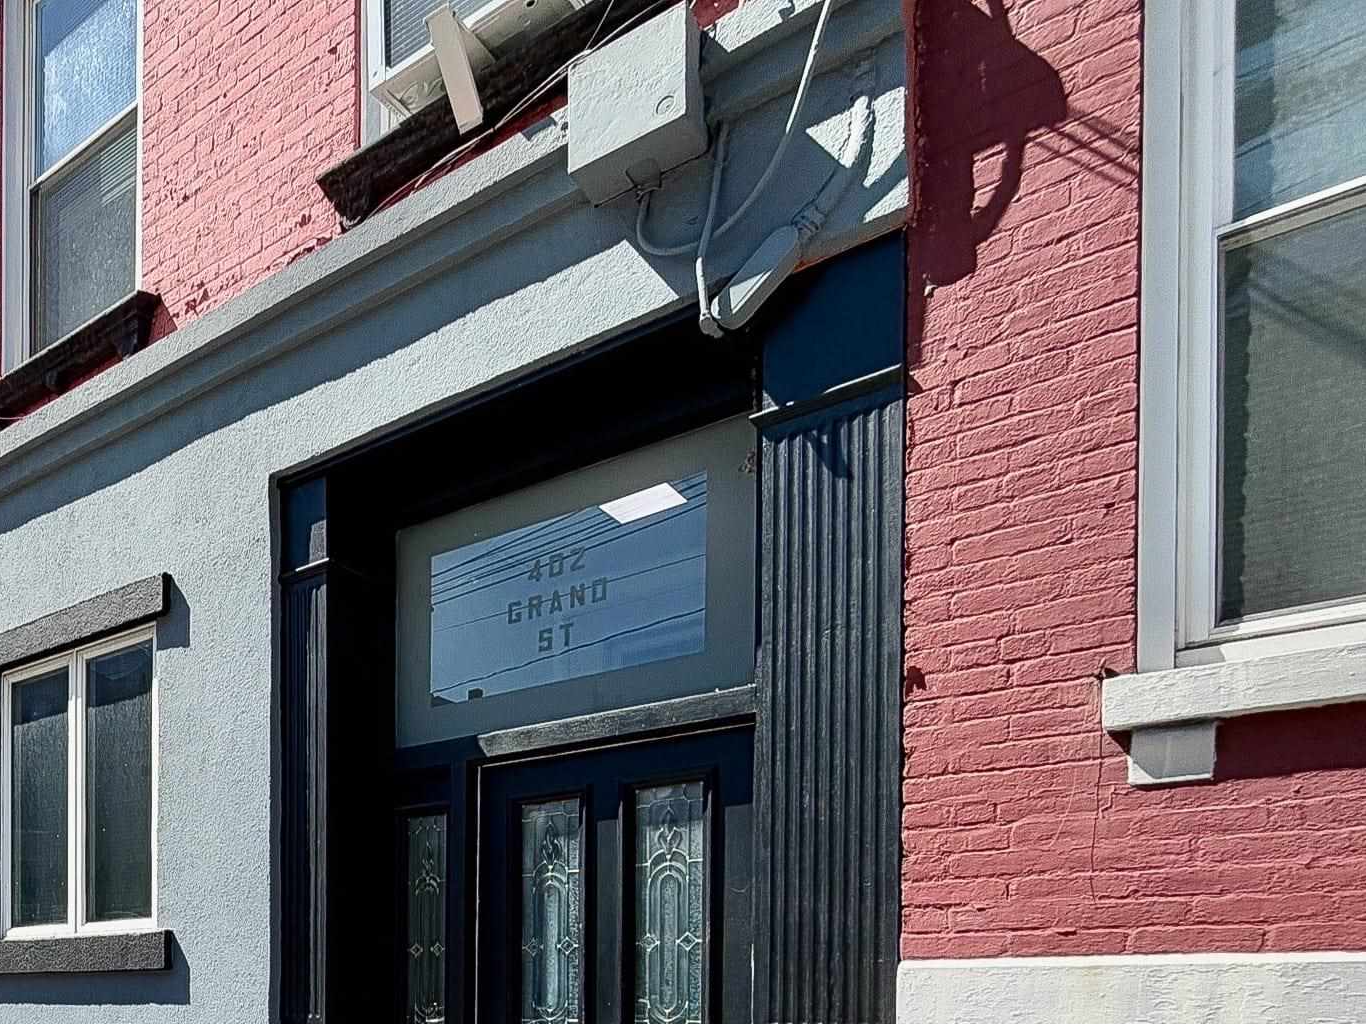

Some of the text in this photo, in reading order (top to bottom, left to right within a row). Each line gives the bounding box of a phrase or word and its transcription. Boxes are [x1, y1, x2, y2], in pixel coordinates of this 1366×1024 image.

[528, 547, 586, 582] 402
[507, 577, 607, 625] GRAND
[538, 622, 574, 652] ST
